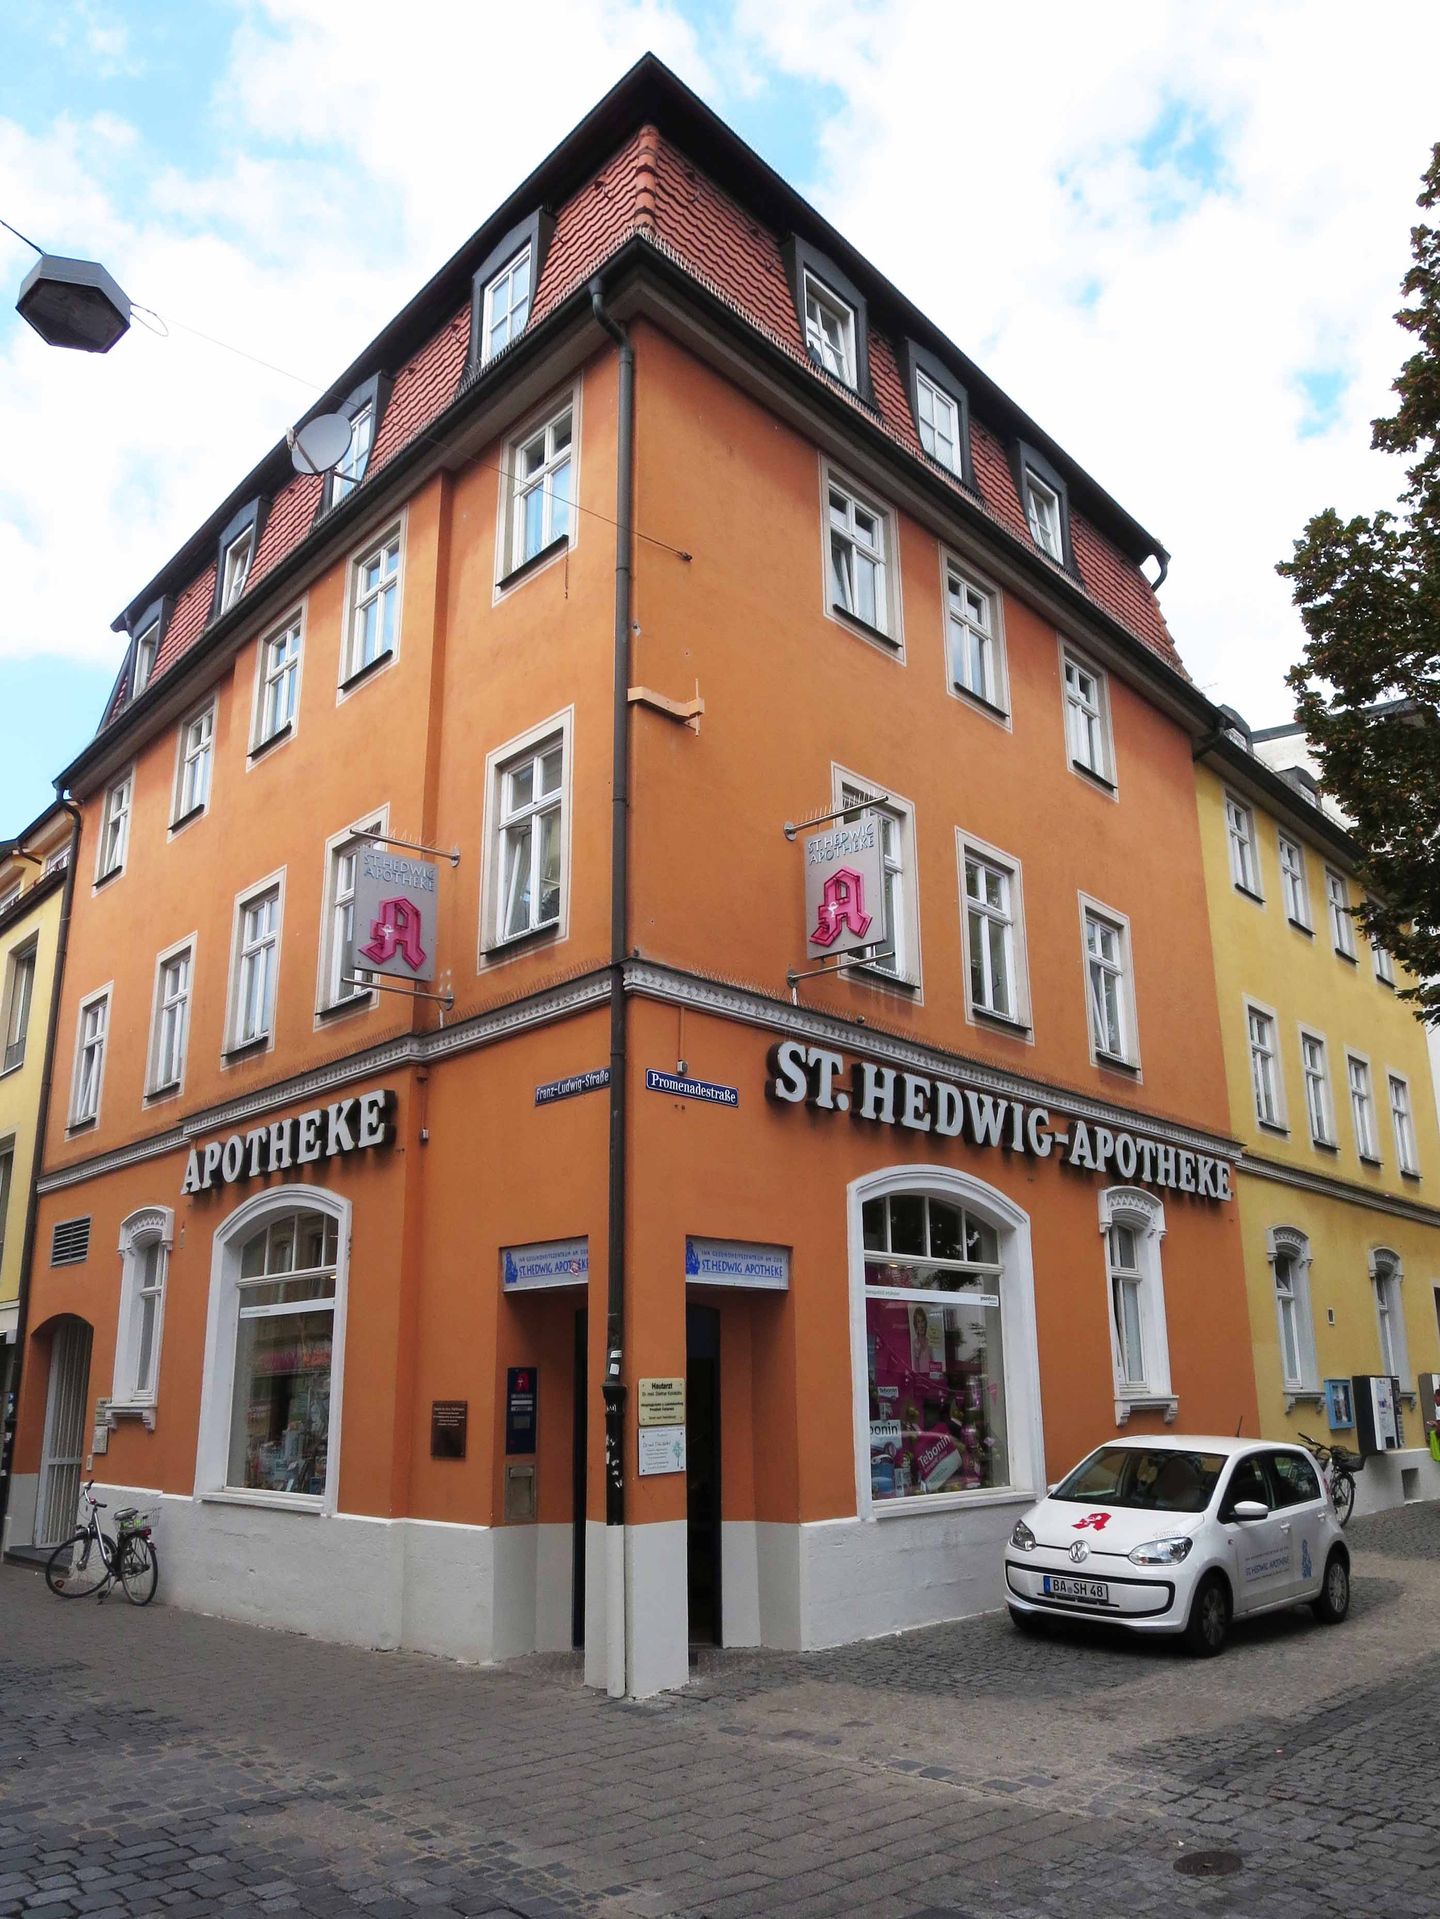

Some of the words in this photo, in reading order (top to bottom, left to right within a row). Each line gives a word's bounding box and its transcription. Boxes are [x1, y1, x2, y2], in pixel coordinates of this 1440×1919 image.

[809, 836, 874, 866] APOTHEKE
[363, 866, 434, 892] APOTHEKE
[536, 1069, 610, 1101] Franz-Ludwig-Straße
[651, 1072, 736, 1104] Promenadestraße
[180, 1089, 388, 1195] APOTHEKE
[744, 1263, 782, 1277] APOTHEKE
[918, 1434, 951, 1467] Tebonin
[1053, 1579, 1067, 1592] BA
[1073, 1582, 1087, 1596] SH
[1090, 1585, 1103, 1597] 48
